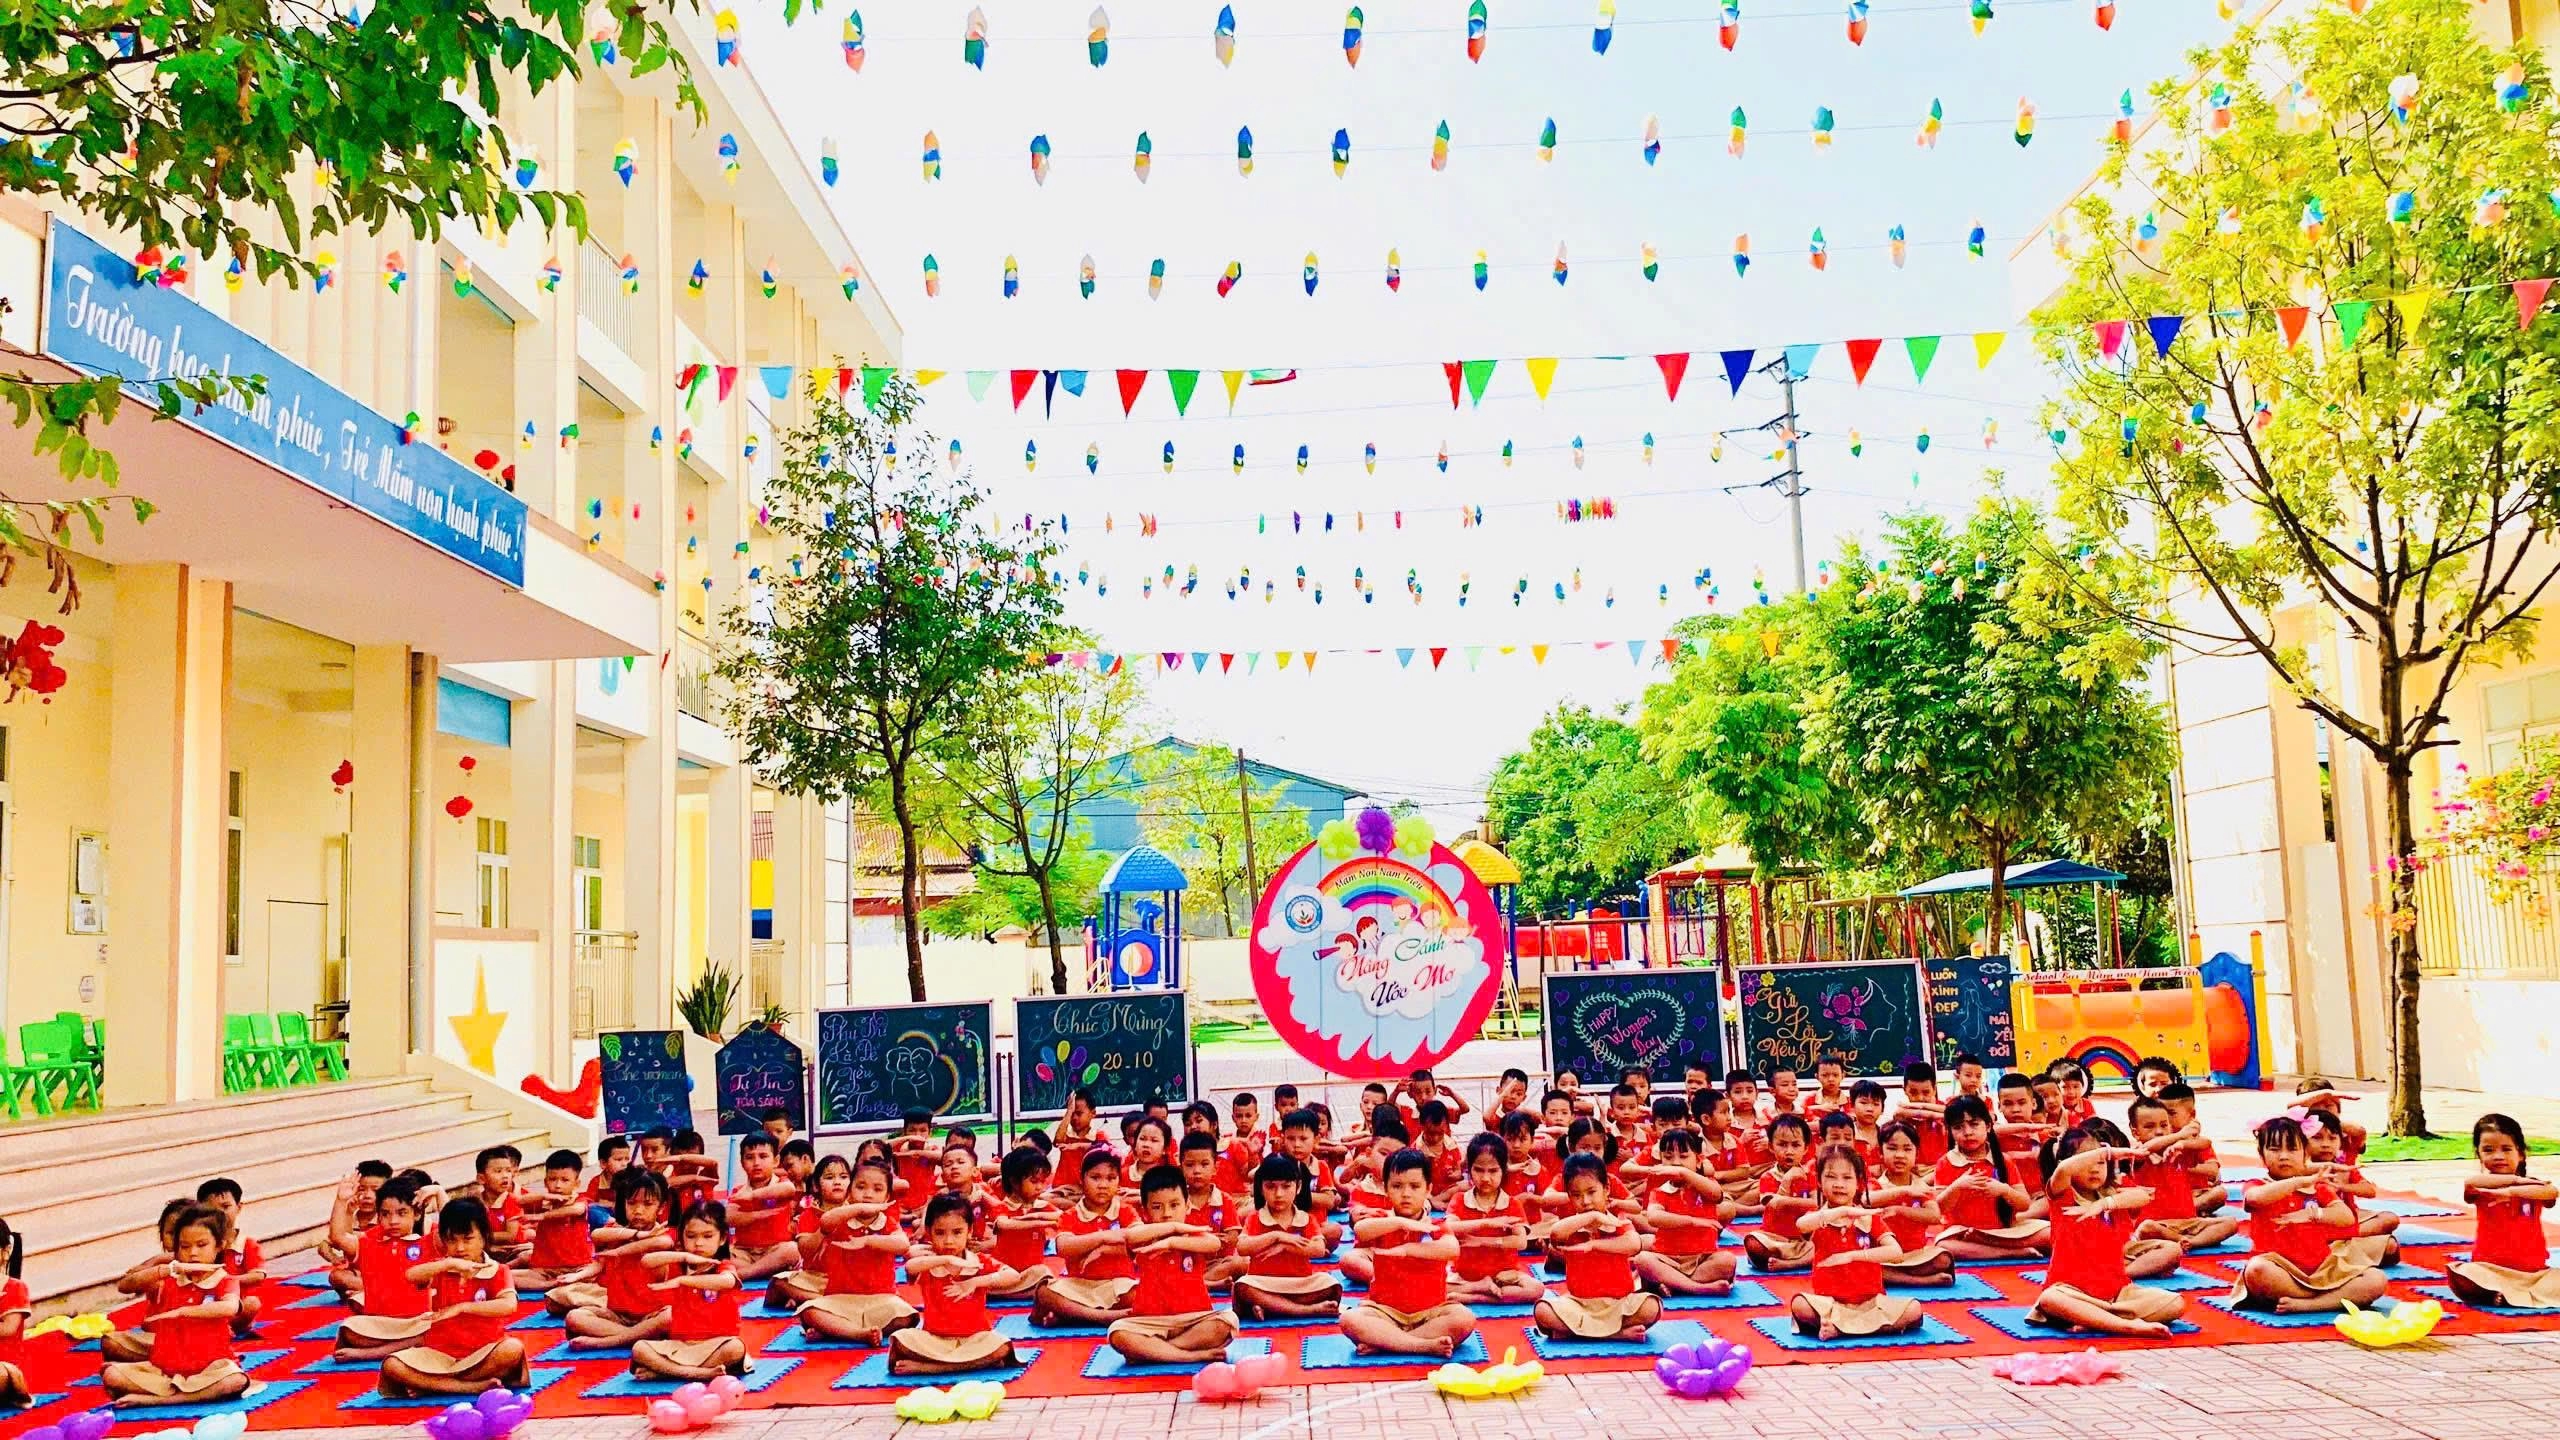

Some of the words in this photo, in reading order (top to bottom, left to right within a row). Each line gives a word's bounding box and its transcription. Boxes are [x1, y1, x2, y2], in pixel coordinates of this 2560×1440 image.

[67, 264, 162, 381] Trường
[415, 485, 444, 524] non
[445, 484, 481, 542] hạnh
[1379, 867, 1401, 879] Nam
[1394, 934, 1446, 962] Cánh
[1052, 1001, 1099, 1034] Chúc
